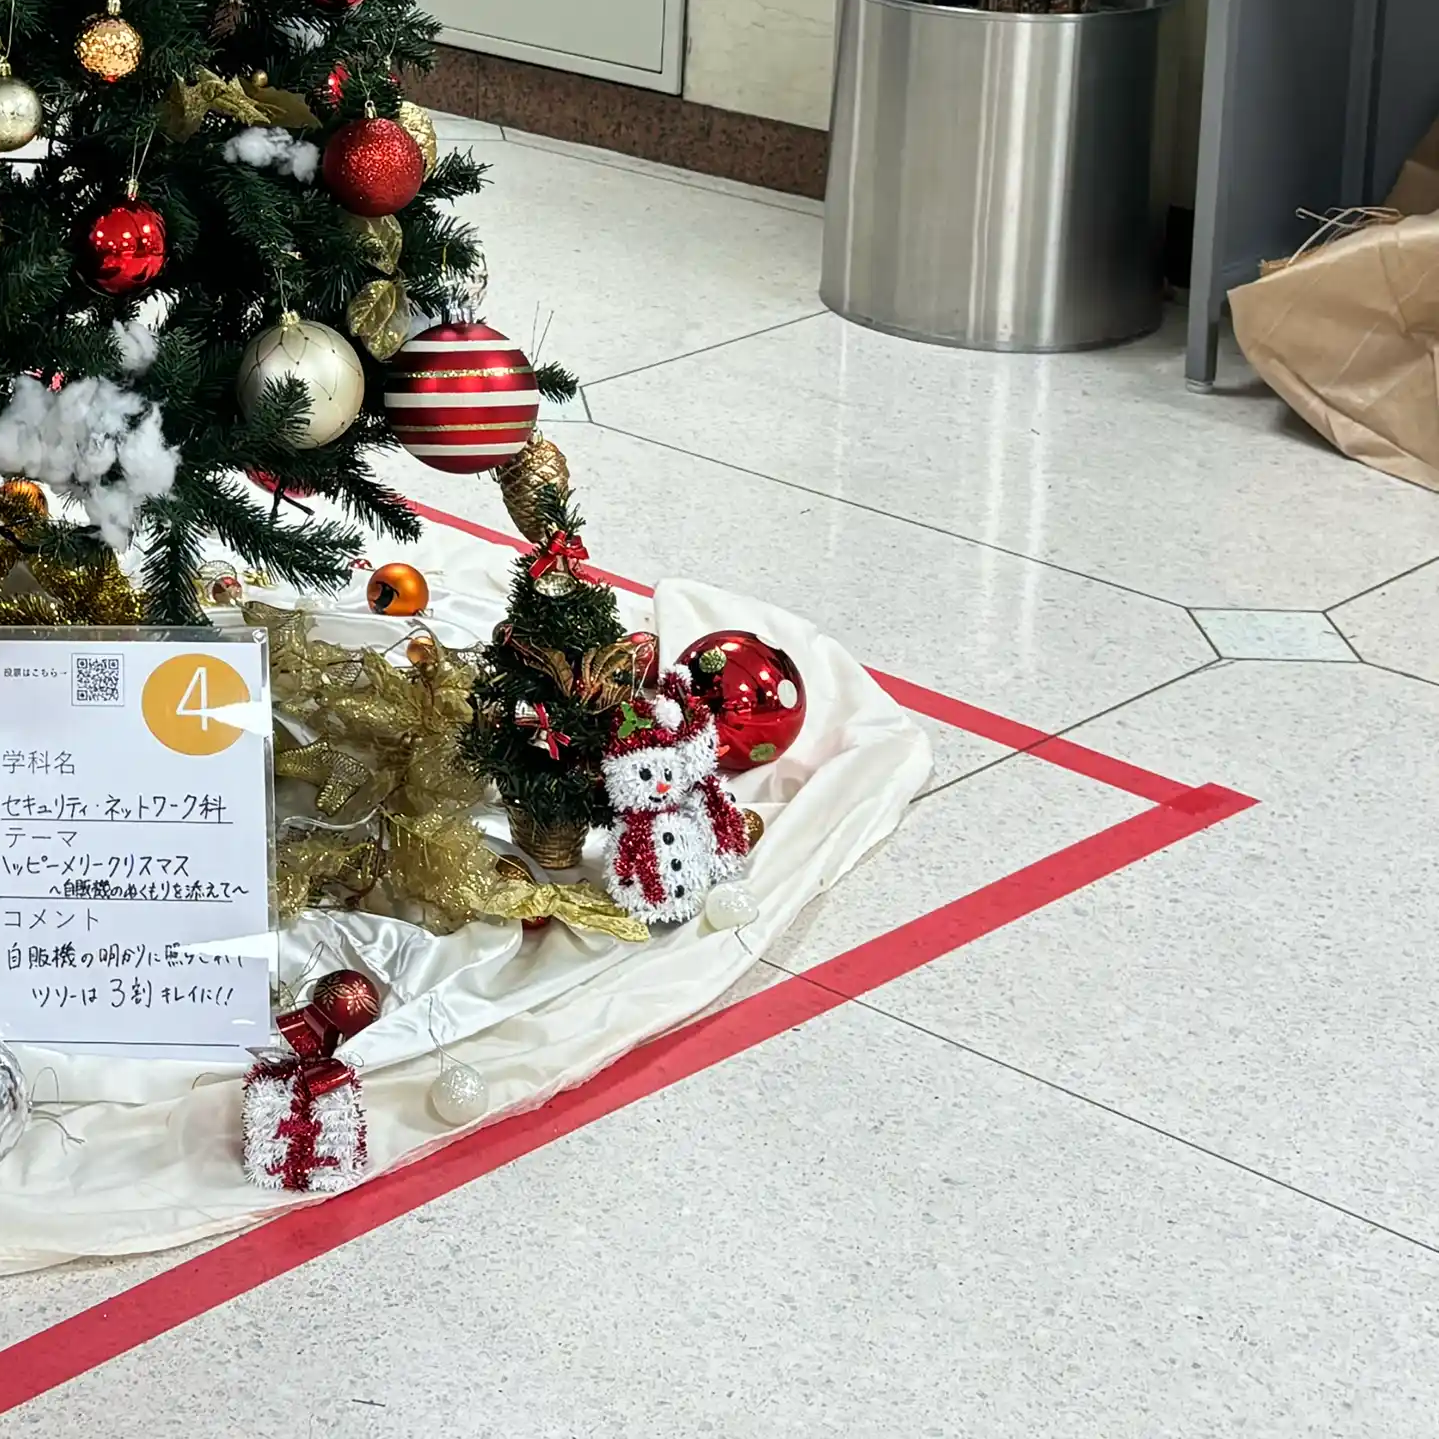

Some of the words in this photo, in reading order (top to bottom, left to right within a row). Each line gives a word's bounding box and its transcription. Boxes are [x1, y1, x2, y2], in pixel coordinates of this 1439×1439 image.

[175, 666, 212, 731] 4
[1, 749, 76, 776] 学科名
[5, 827, 78, 848] テーマ
[4, 907, 100, 932] コメント
